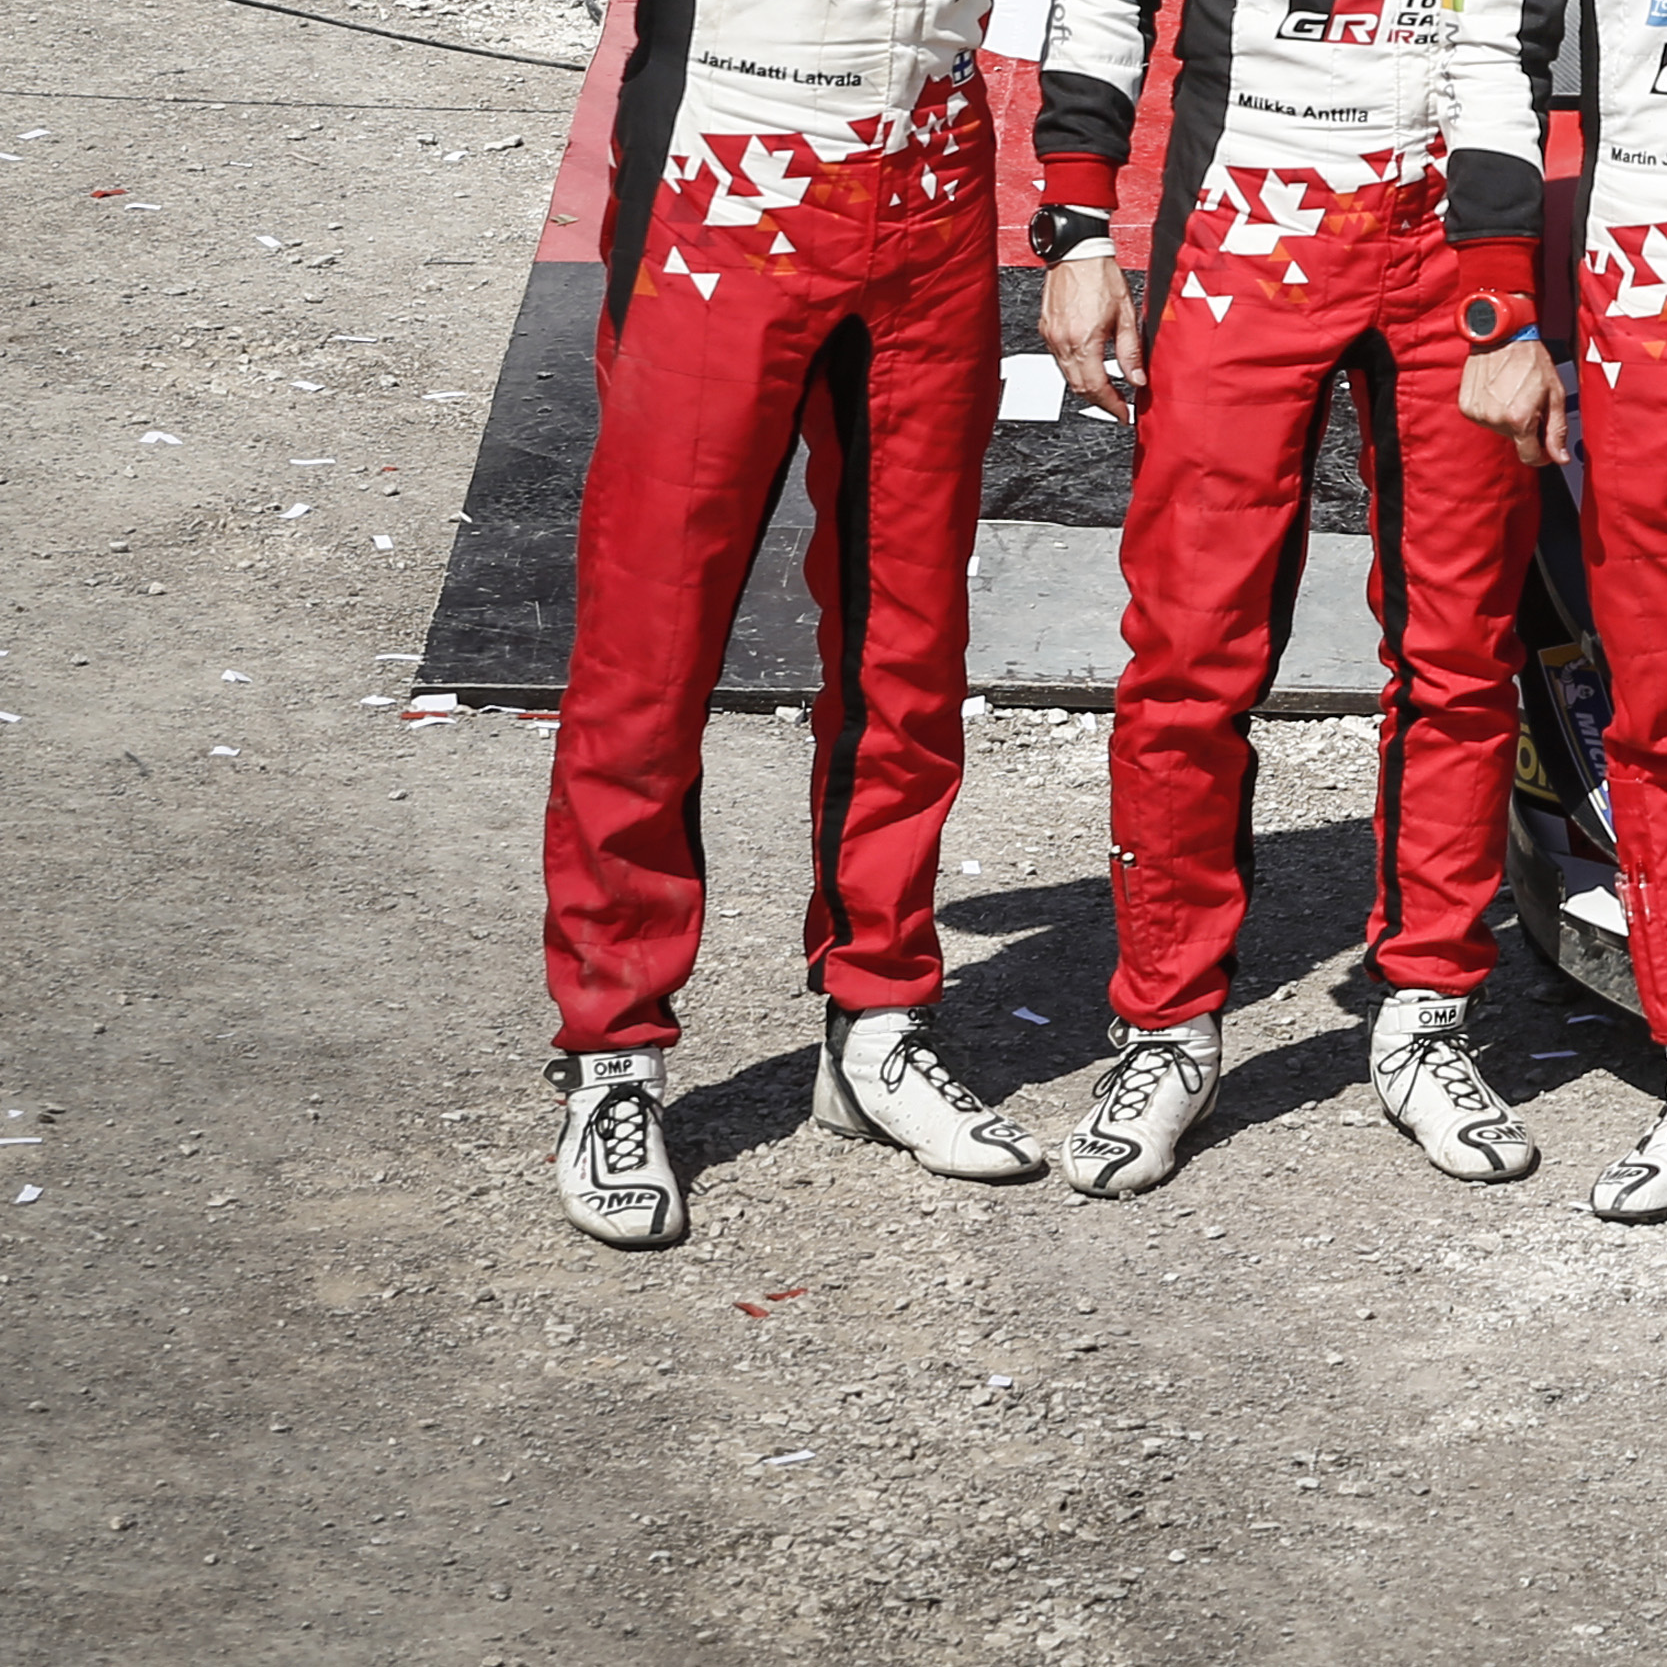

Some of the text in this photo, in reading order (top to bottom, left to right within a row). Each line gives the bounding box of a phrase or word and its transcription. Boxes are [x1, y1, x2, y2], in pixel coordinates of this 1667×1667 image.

[1281, 11, 1374, 45] GR
[698, 50, 862, 87] Jari-Matti Latvala
[1611, 148, 1657, 166] Martin
[1418, 1007, 1458, 1026] OMP
[593, 1058, 634, 1078] OMP
